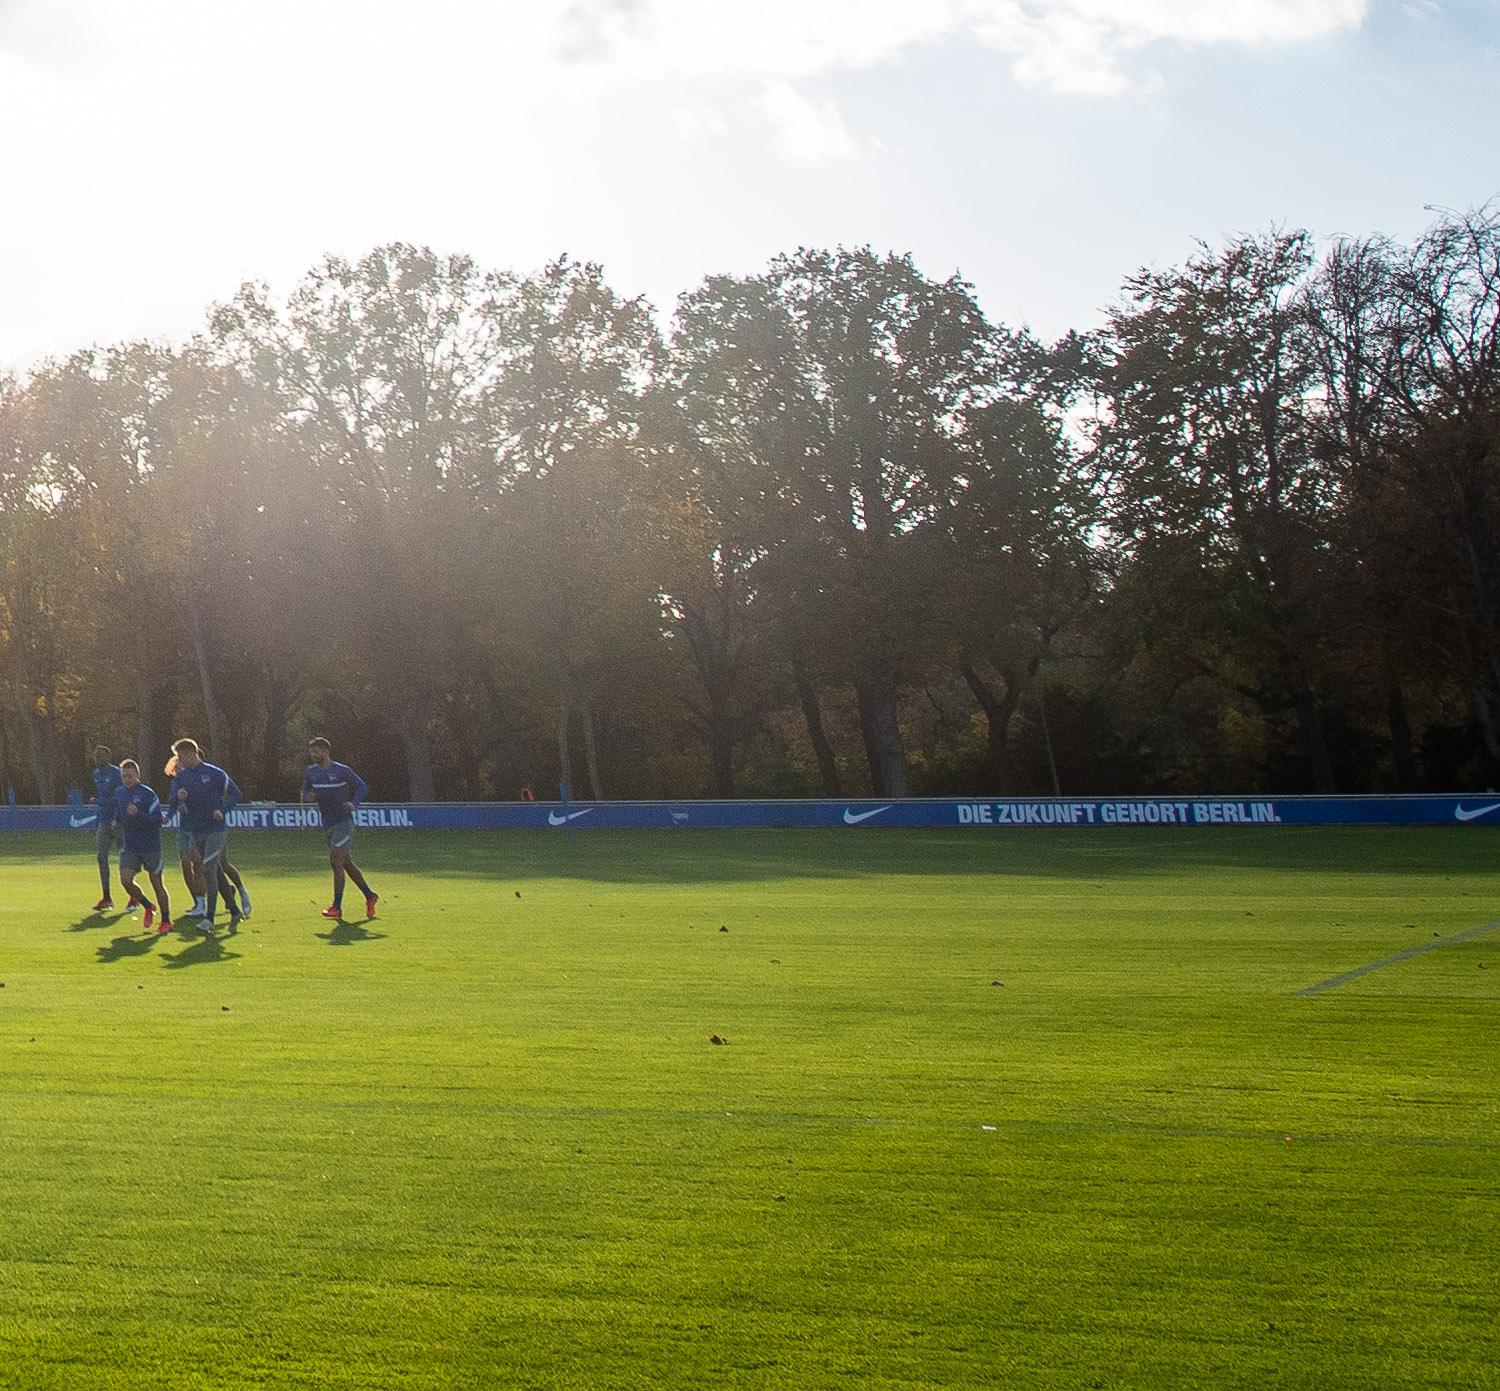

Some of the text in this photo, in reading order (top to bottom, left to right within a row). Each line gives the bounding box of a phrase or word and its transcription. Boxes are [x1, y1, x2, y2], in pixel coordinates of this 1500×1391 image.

[957, 800, 1282, 824] DIE ZUKUNFT GEHÖRT BERLIN.
